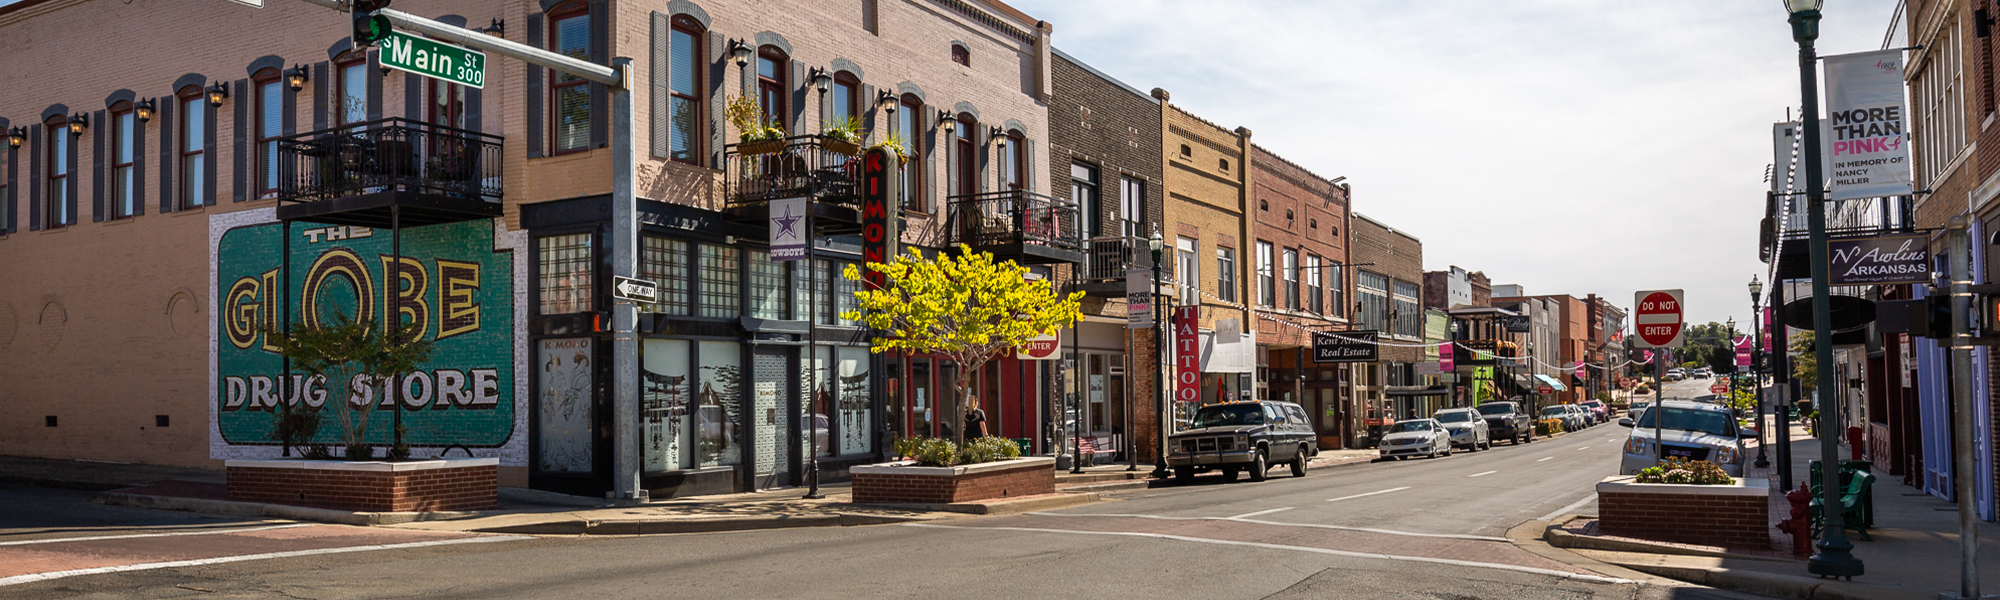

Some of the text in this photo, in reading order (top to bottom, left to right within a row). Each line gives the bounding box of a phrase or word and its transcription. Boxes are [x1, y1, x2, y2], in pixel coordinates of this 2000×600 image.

[392, 36, 452, 75] Main
[464, 53, 477, 68] St
[457, 66, 482, 84] 300
[1832, 106, 1900, 125] MORE
[1833, 121, 1901, 140] THAN
[1833, 137, 1890, 156] PINK
[1847, 157, 1888, 168] MEMORY
[1890, 156, 1904, 164] OF
[1835, 168, 1869, 177] NANCY
[1836, 177, 1869, 186] MILLER
[863, 152, 885, 289] KIMONO
[303, 225, 374, 243] THE
[1843, 263, 1927, 276] ARKANSAS
[628, 284, 653, 296] ONE WAY
[224, 247, 480, 361] GLOBE
[1642, 300, 1675, 311] DO NOT
[1645, 326, 1672, 335] ENTER
[1027, 342, 1051, 350] ENTER
[1317, 333, 1374, 346] Kent Arnold
[1180, 306, 1196, 400] TATTOO
[1321, 346, 1371, 357] Real Estate
[223, 368, 499, 411] DRUG STORE
